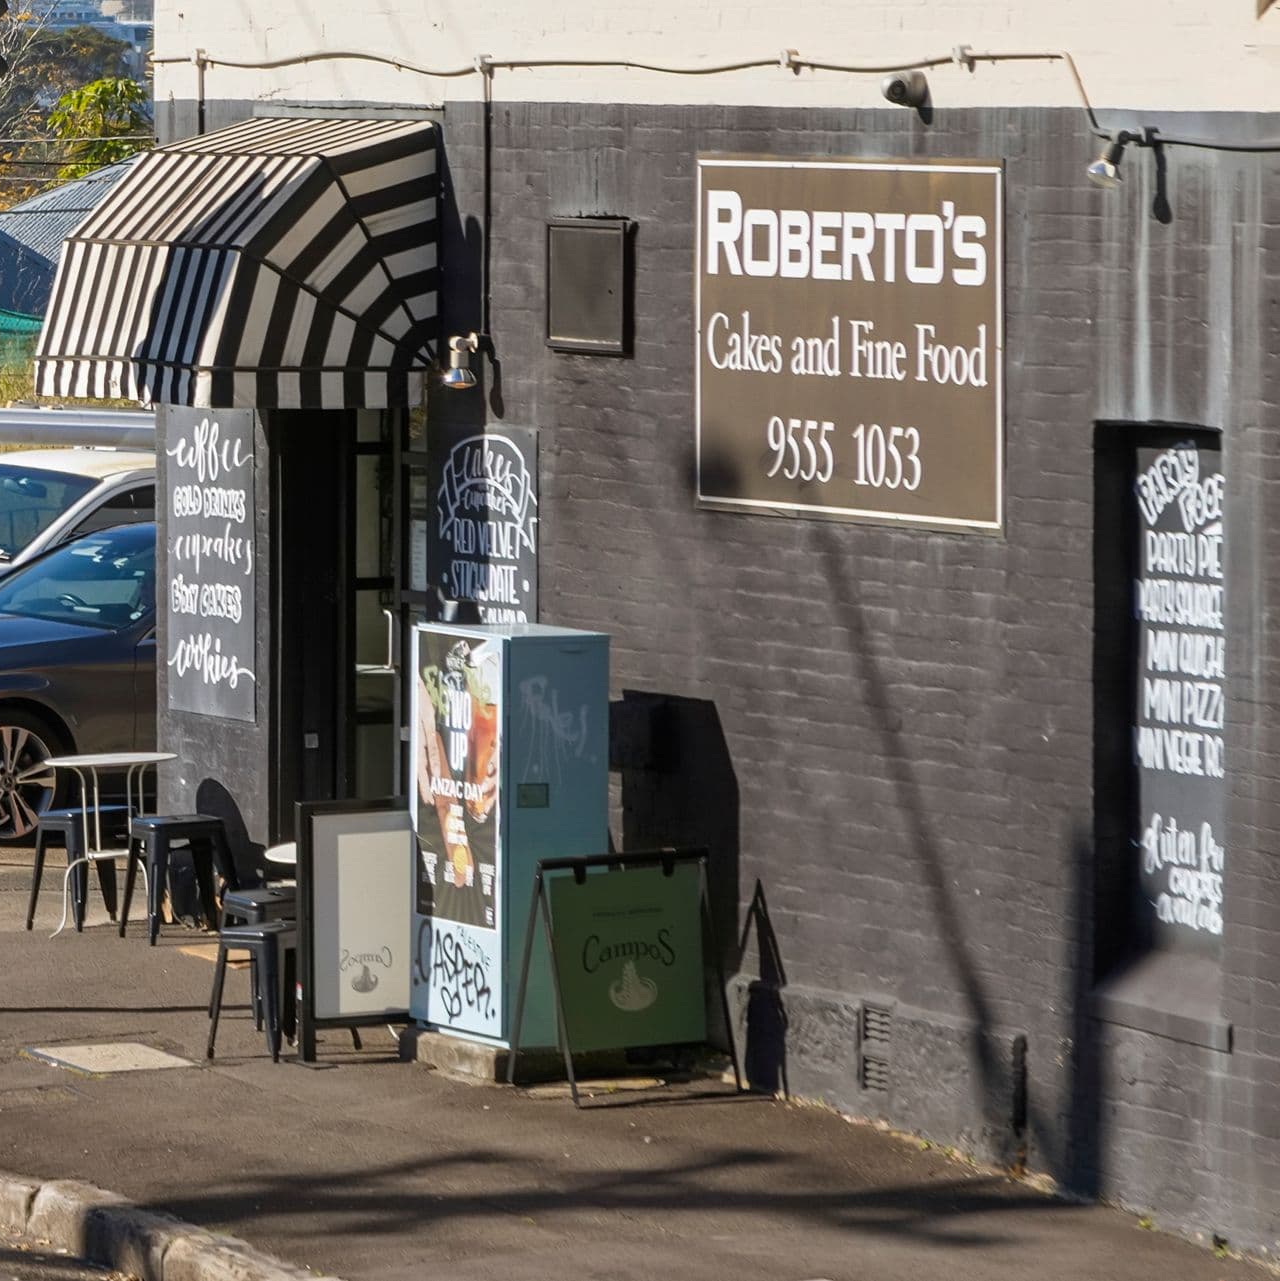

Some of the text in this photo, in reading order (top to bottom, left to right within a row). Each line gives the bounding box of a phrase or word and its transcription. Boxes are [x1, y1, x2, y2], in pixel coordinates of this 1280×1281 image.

[707, 189, 987, 287] ROBERTO'S
[706, 310, 989, 388] Cakes and Fine Food
[765, 415, 922, 491] 9555 1053
[167, 632, 256, 689] cookies
[450, 730, 468, 772] UP
[430, 776, 483, 803] ANZAC DAY
